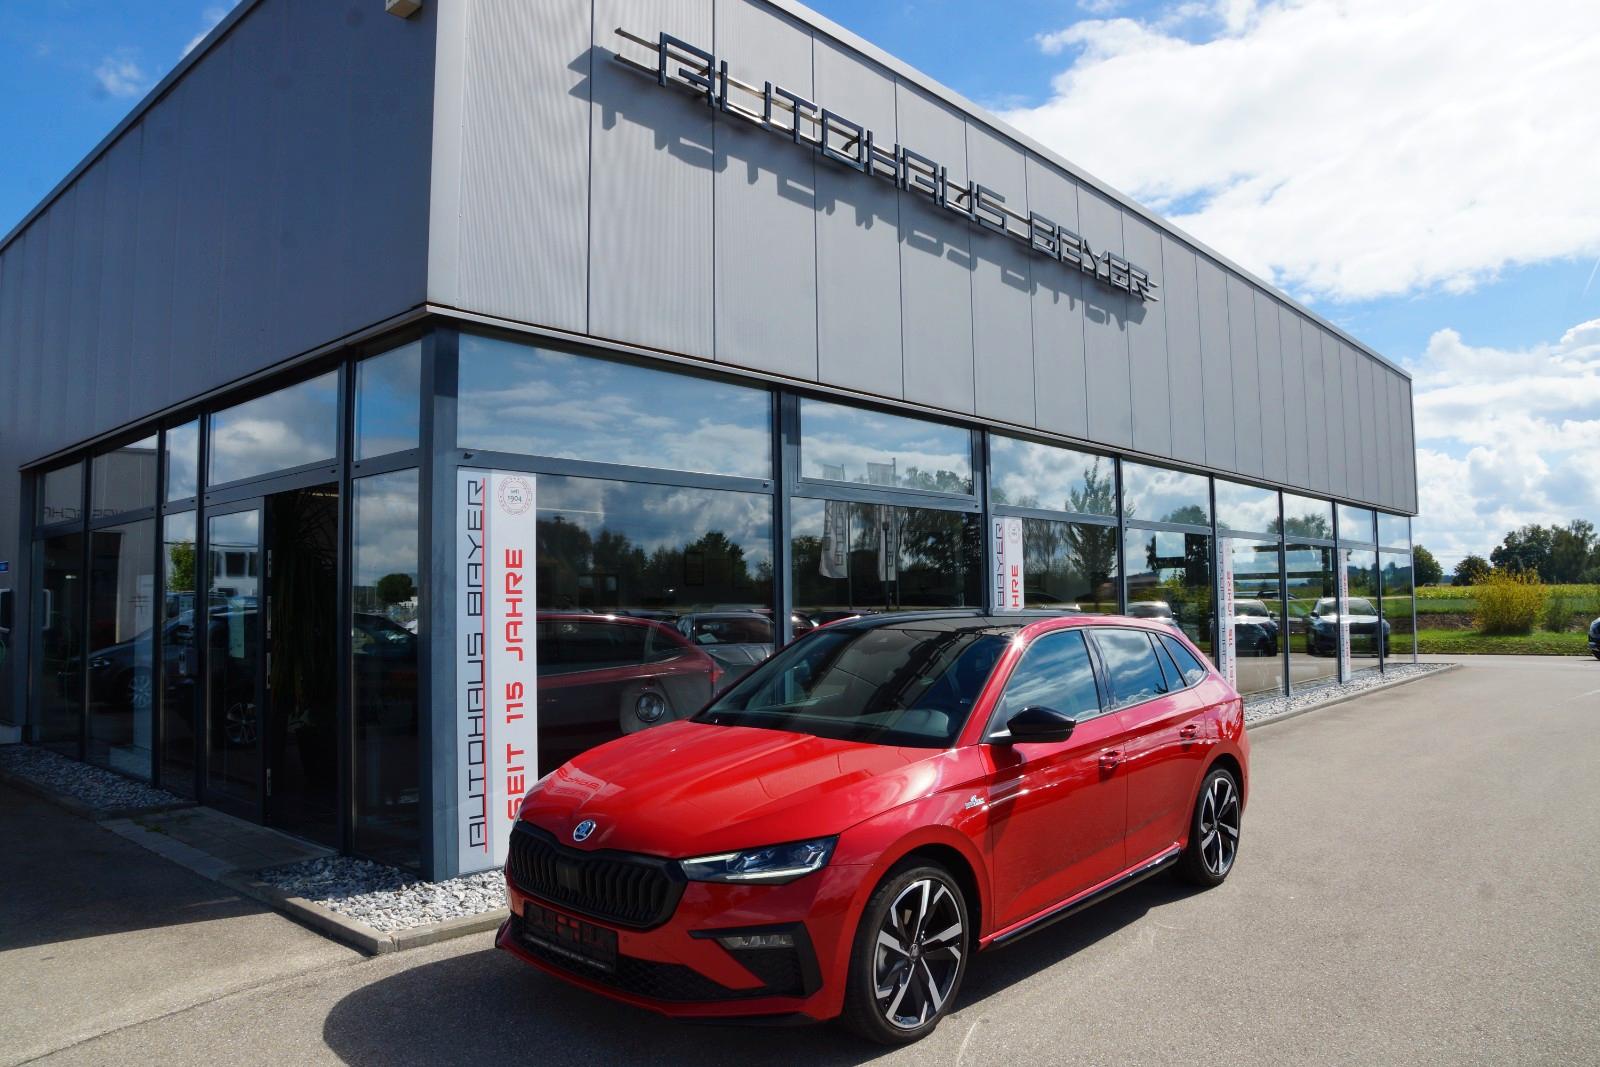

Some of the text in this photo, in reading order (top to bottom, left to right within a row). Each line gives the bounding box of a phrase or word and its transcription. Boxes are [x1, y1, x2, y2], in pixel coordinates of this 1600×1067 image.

[658, 31, 1152, 300] AUTOHAUS BAYER
[466, 479, 485, 848] AUTOHAUS BAYER
[504, 548, 525, 820] SEIT 115 JAHRE
[995, 523, 1005, 607] BAYER
[1011, 564, 1020, 608] HRE
